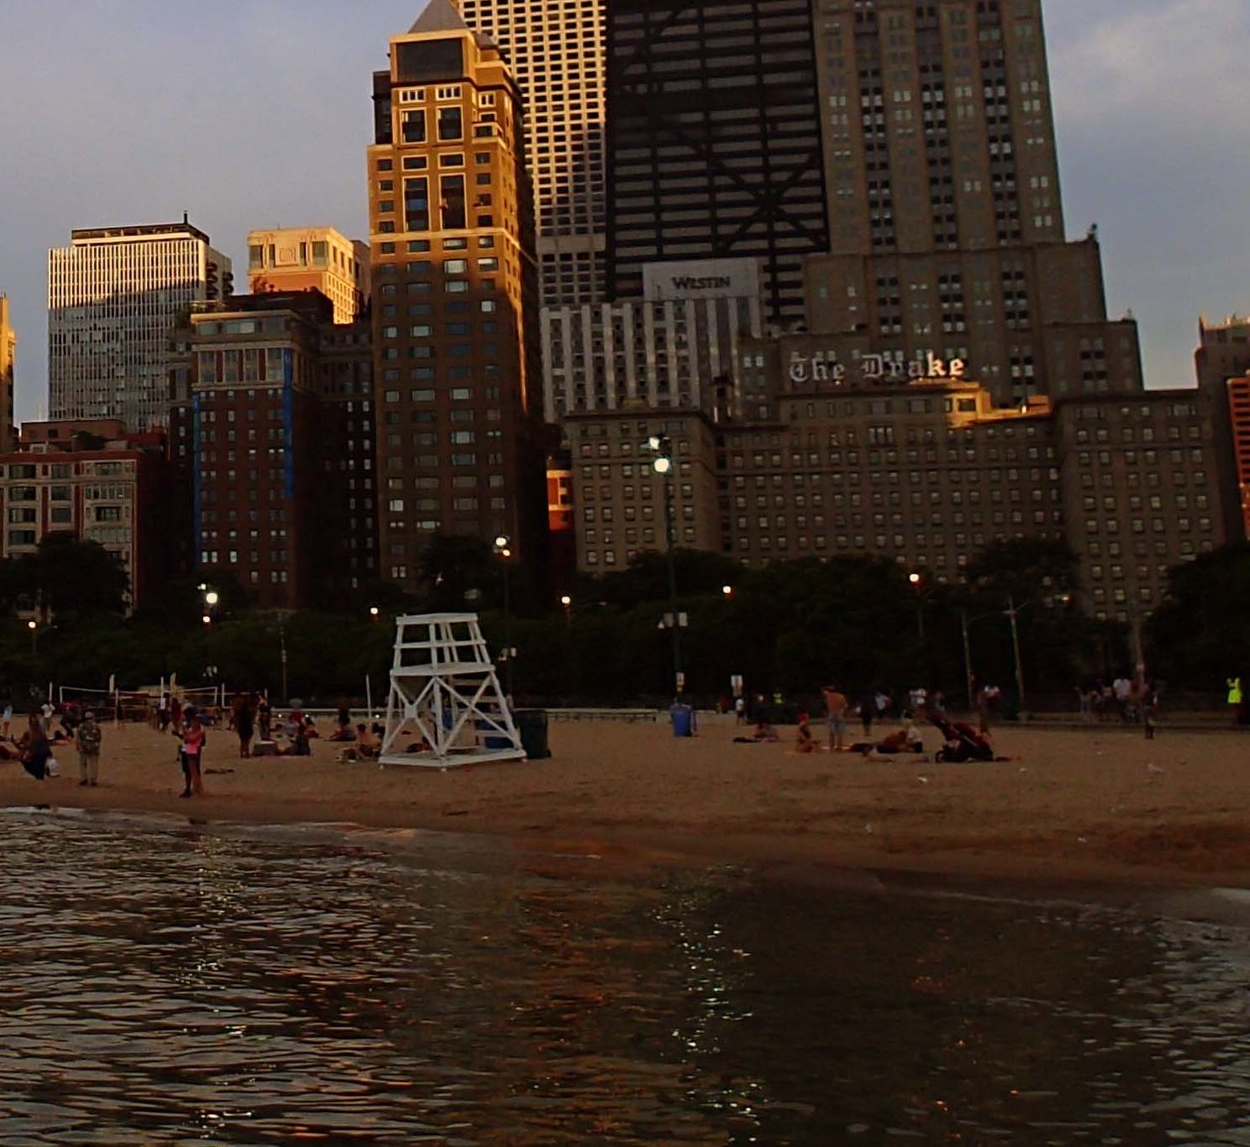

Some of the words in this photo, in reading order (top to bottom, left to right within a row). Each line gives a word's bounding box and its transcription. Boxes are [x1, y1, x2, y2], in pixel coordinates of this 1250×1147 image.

[672, 276, 731, 290] WESTIN
[789, 357, 846, 382] The
[860, 351, 965, 379] Drake
